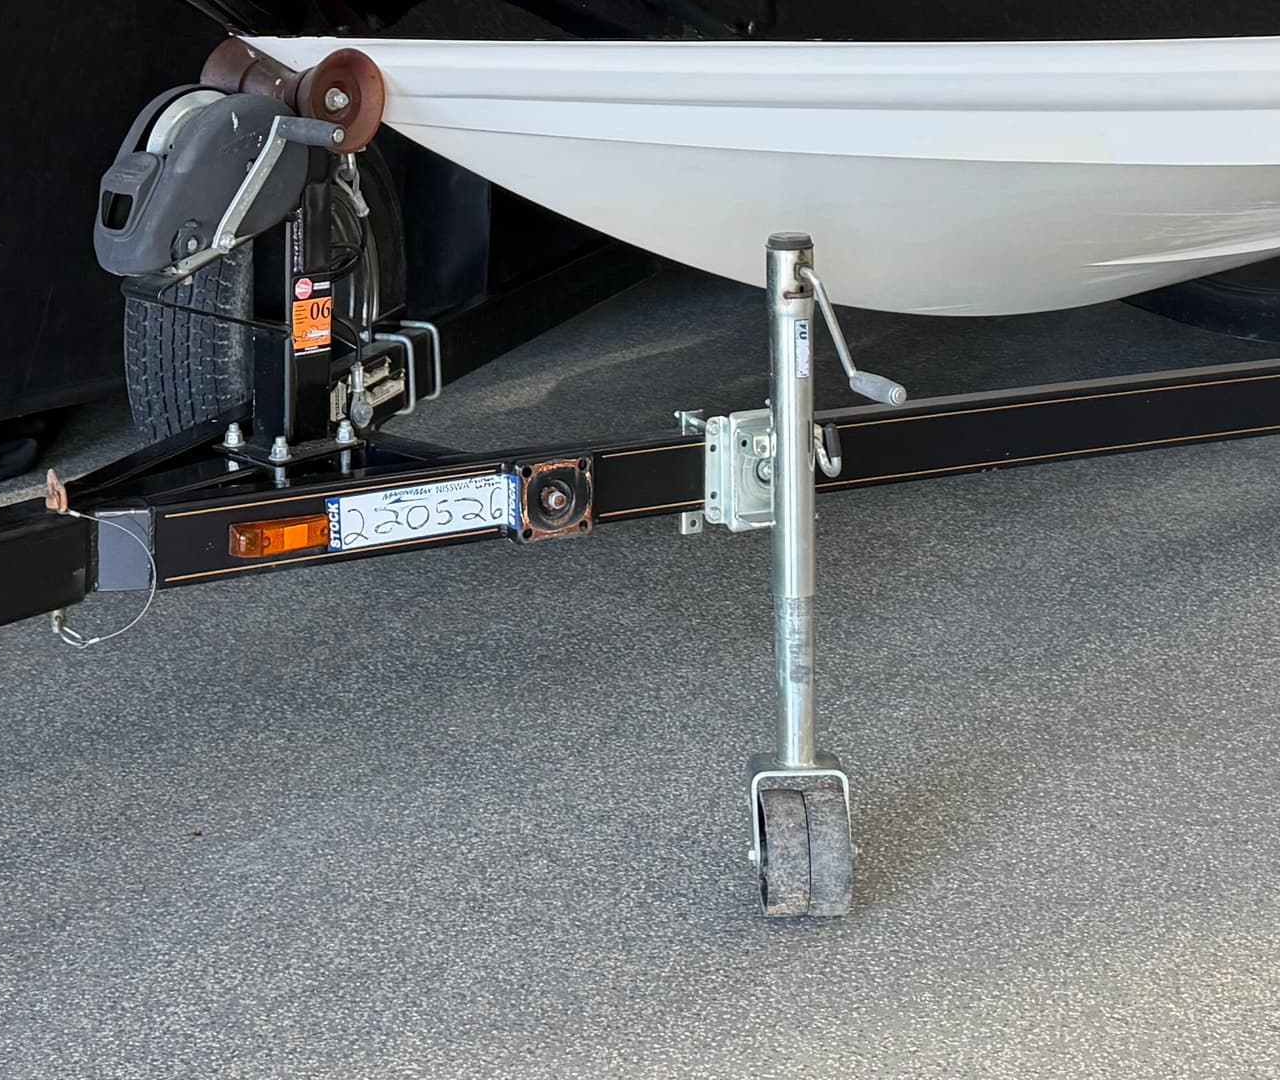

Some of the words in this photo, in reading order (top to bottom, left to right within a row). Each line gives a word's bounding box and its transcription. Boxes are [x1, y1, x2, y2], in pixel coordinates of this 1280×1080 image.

[310, 298, 331, 320] 06
[435, 481, 470, 494] NISSWA
[328, 502, 341, 549] STOCK
[343, 486, 504, 546] 220526
